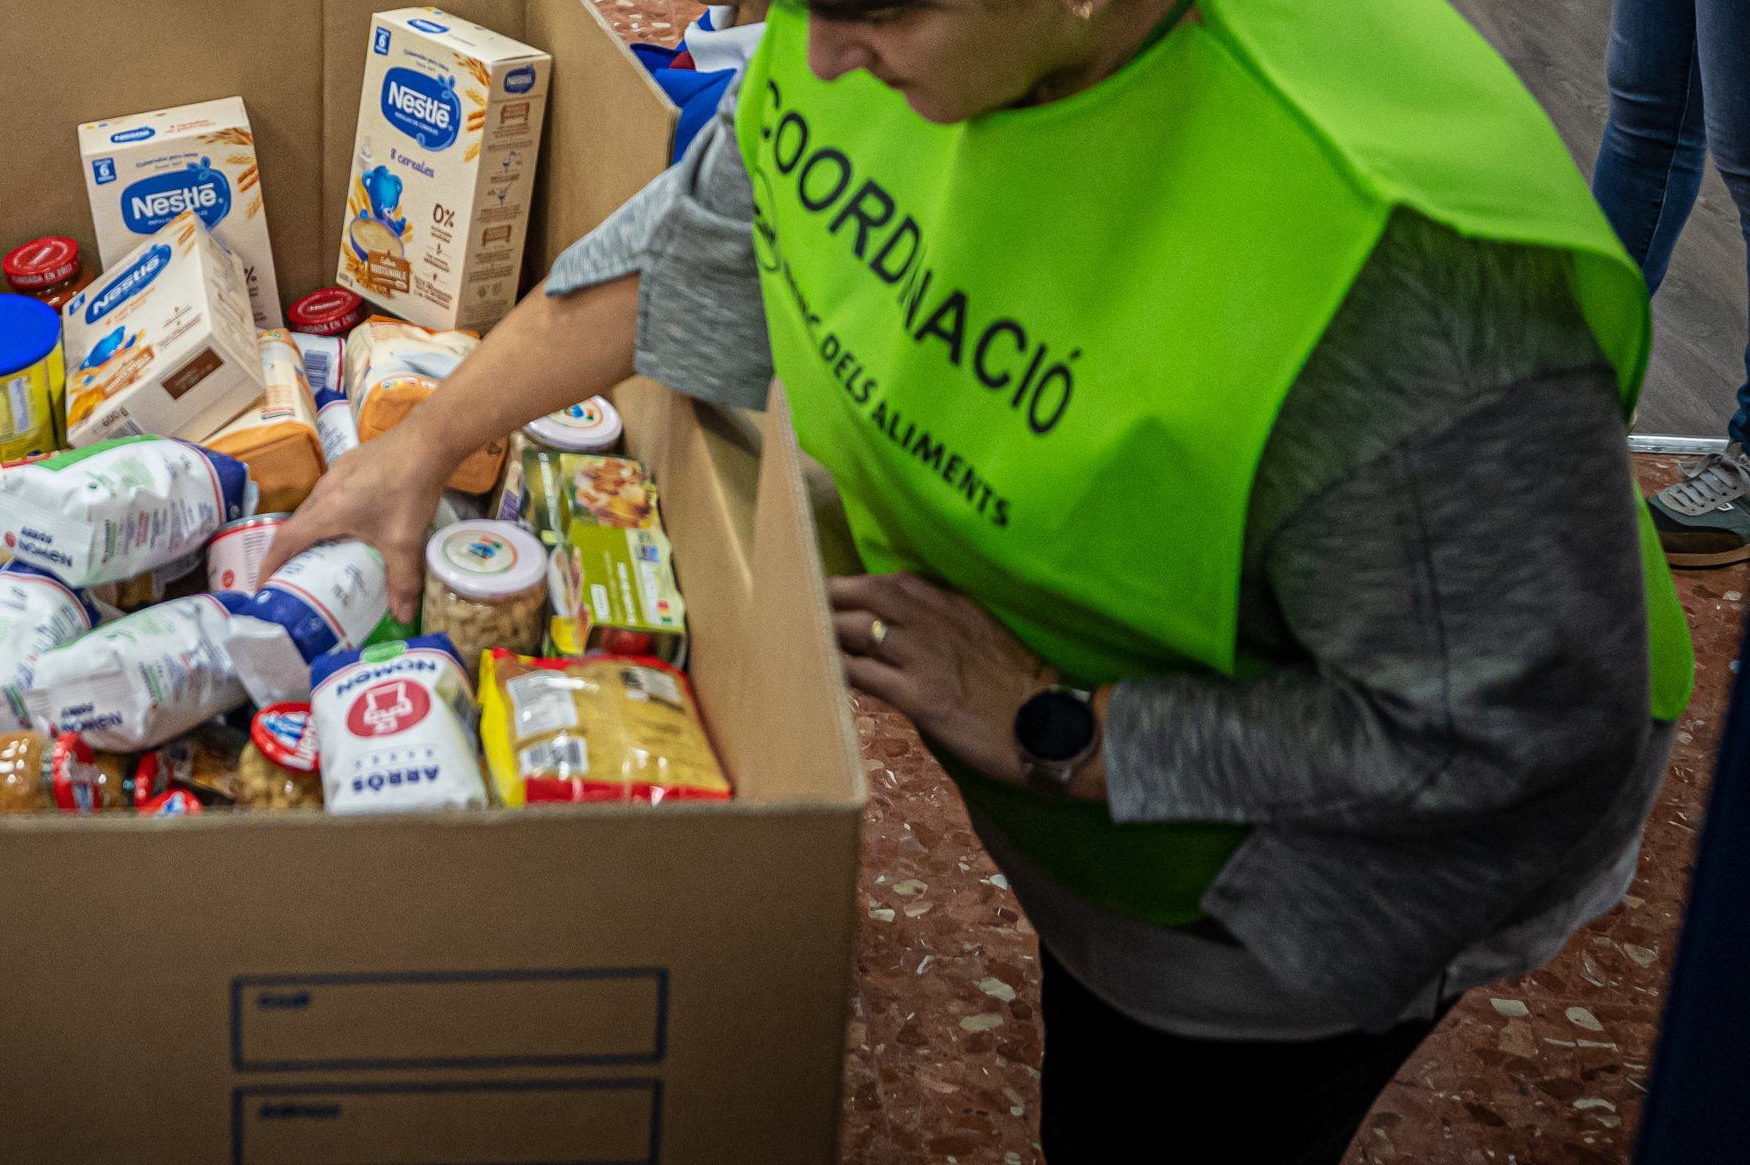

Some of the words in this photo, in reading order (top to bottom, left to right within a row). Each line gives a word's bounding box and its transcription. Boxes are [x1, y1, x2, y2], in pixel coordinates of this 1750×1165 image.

[397, 151, 434, 178] cereales
[433, 202, 454, 229] 0%
[819, 334, 879, 407] DELS
[870, 400, 1013, 528] ALIMENTS
